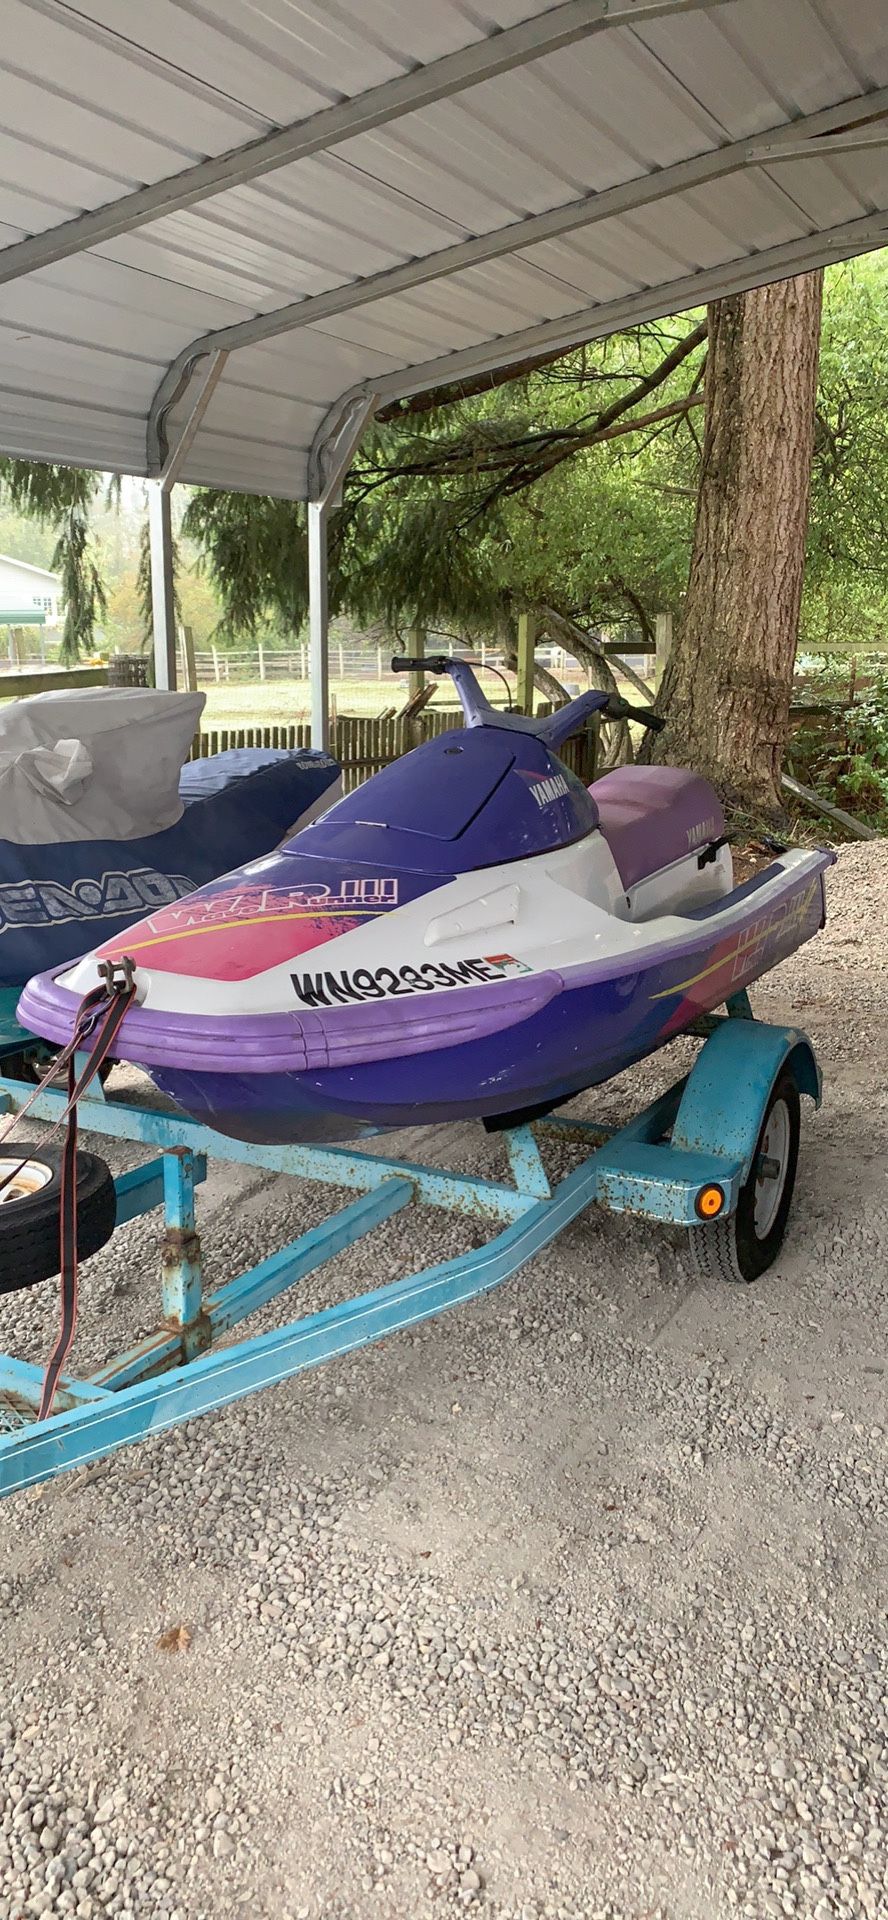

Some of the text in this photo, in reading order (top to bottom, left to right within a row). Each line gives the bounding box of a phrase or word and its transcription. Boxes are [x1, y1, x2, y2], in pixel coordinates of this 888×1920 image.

[528, 774, 570, 807] YAMAHA
[686, 816, 715, 850] YAMAHA
[290, 958, 508, 1007] WN9283ME
